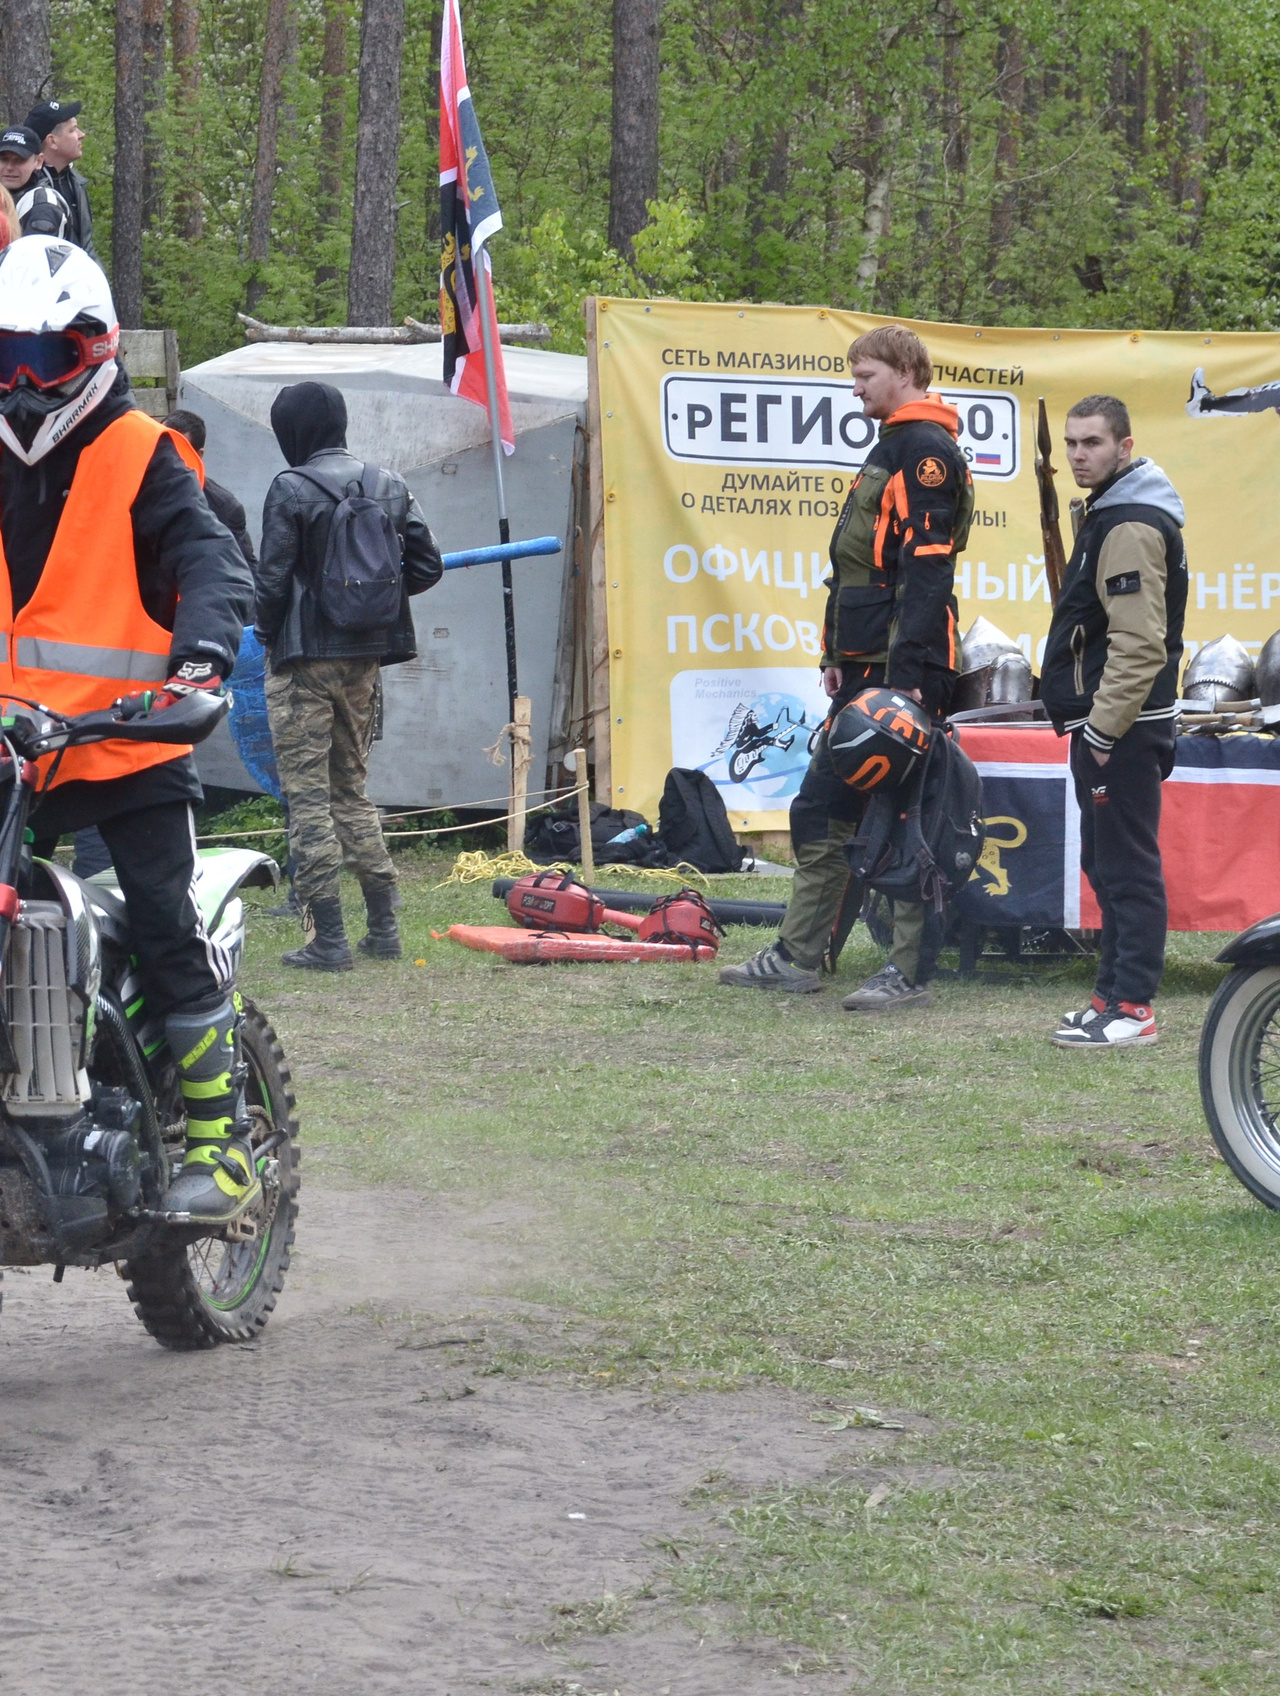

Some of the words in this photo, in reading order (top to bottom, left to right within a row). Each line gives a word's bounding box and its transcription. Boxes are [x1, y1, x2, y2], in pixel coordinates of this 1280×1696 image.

[662, 348, 710, 367] СЕТЬ
[717, 351, 845, 373] МАГАЗИНОВ
[932, 364, 1024, 386] ПЧАСТЕЙ
[687, 392, 876, 449] РЕГИО
[722, 472, 825, 493] ДУМАЙТЕ
[681, 492, 696, 508] О
[701, 495, 792, 516] ДЕТАЛЯХ
[667, 612, 821, 657] ПСКОВ
[694, 677, 742, 688] Positive
[694, 688, 758, 699] Mechanics
